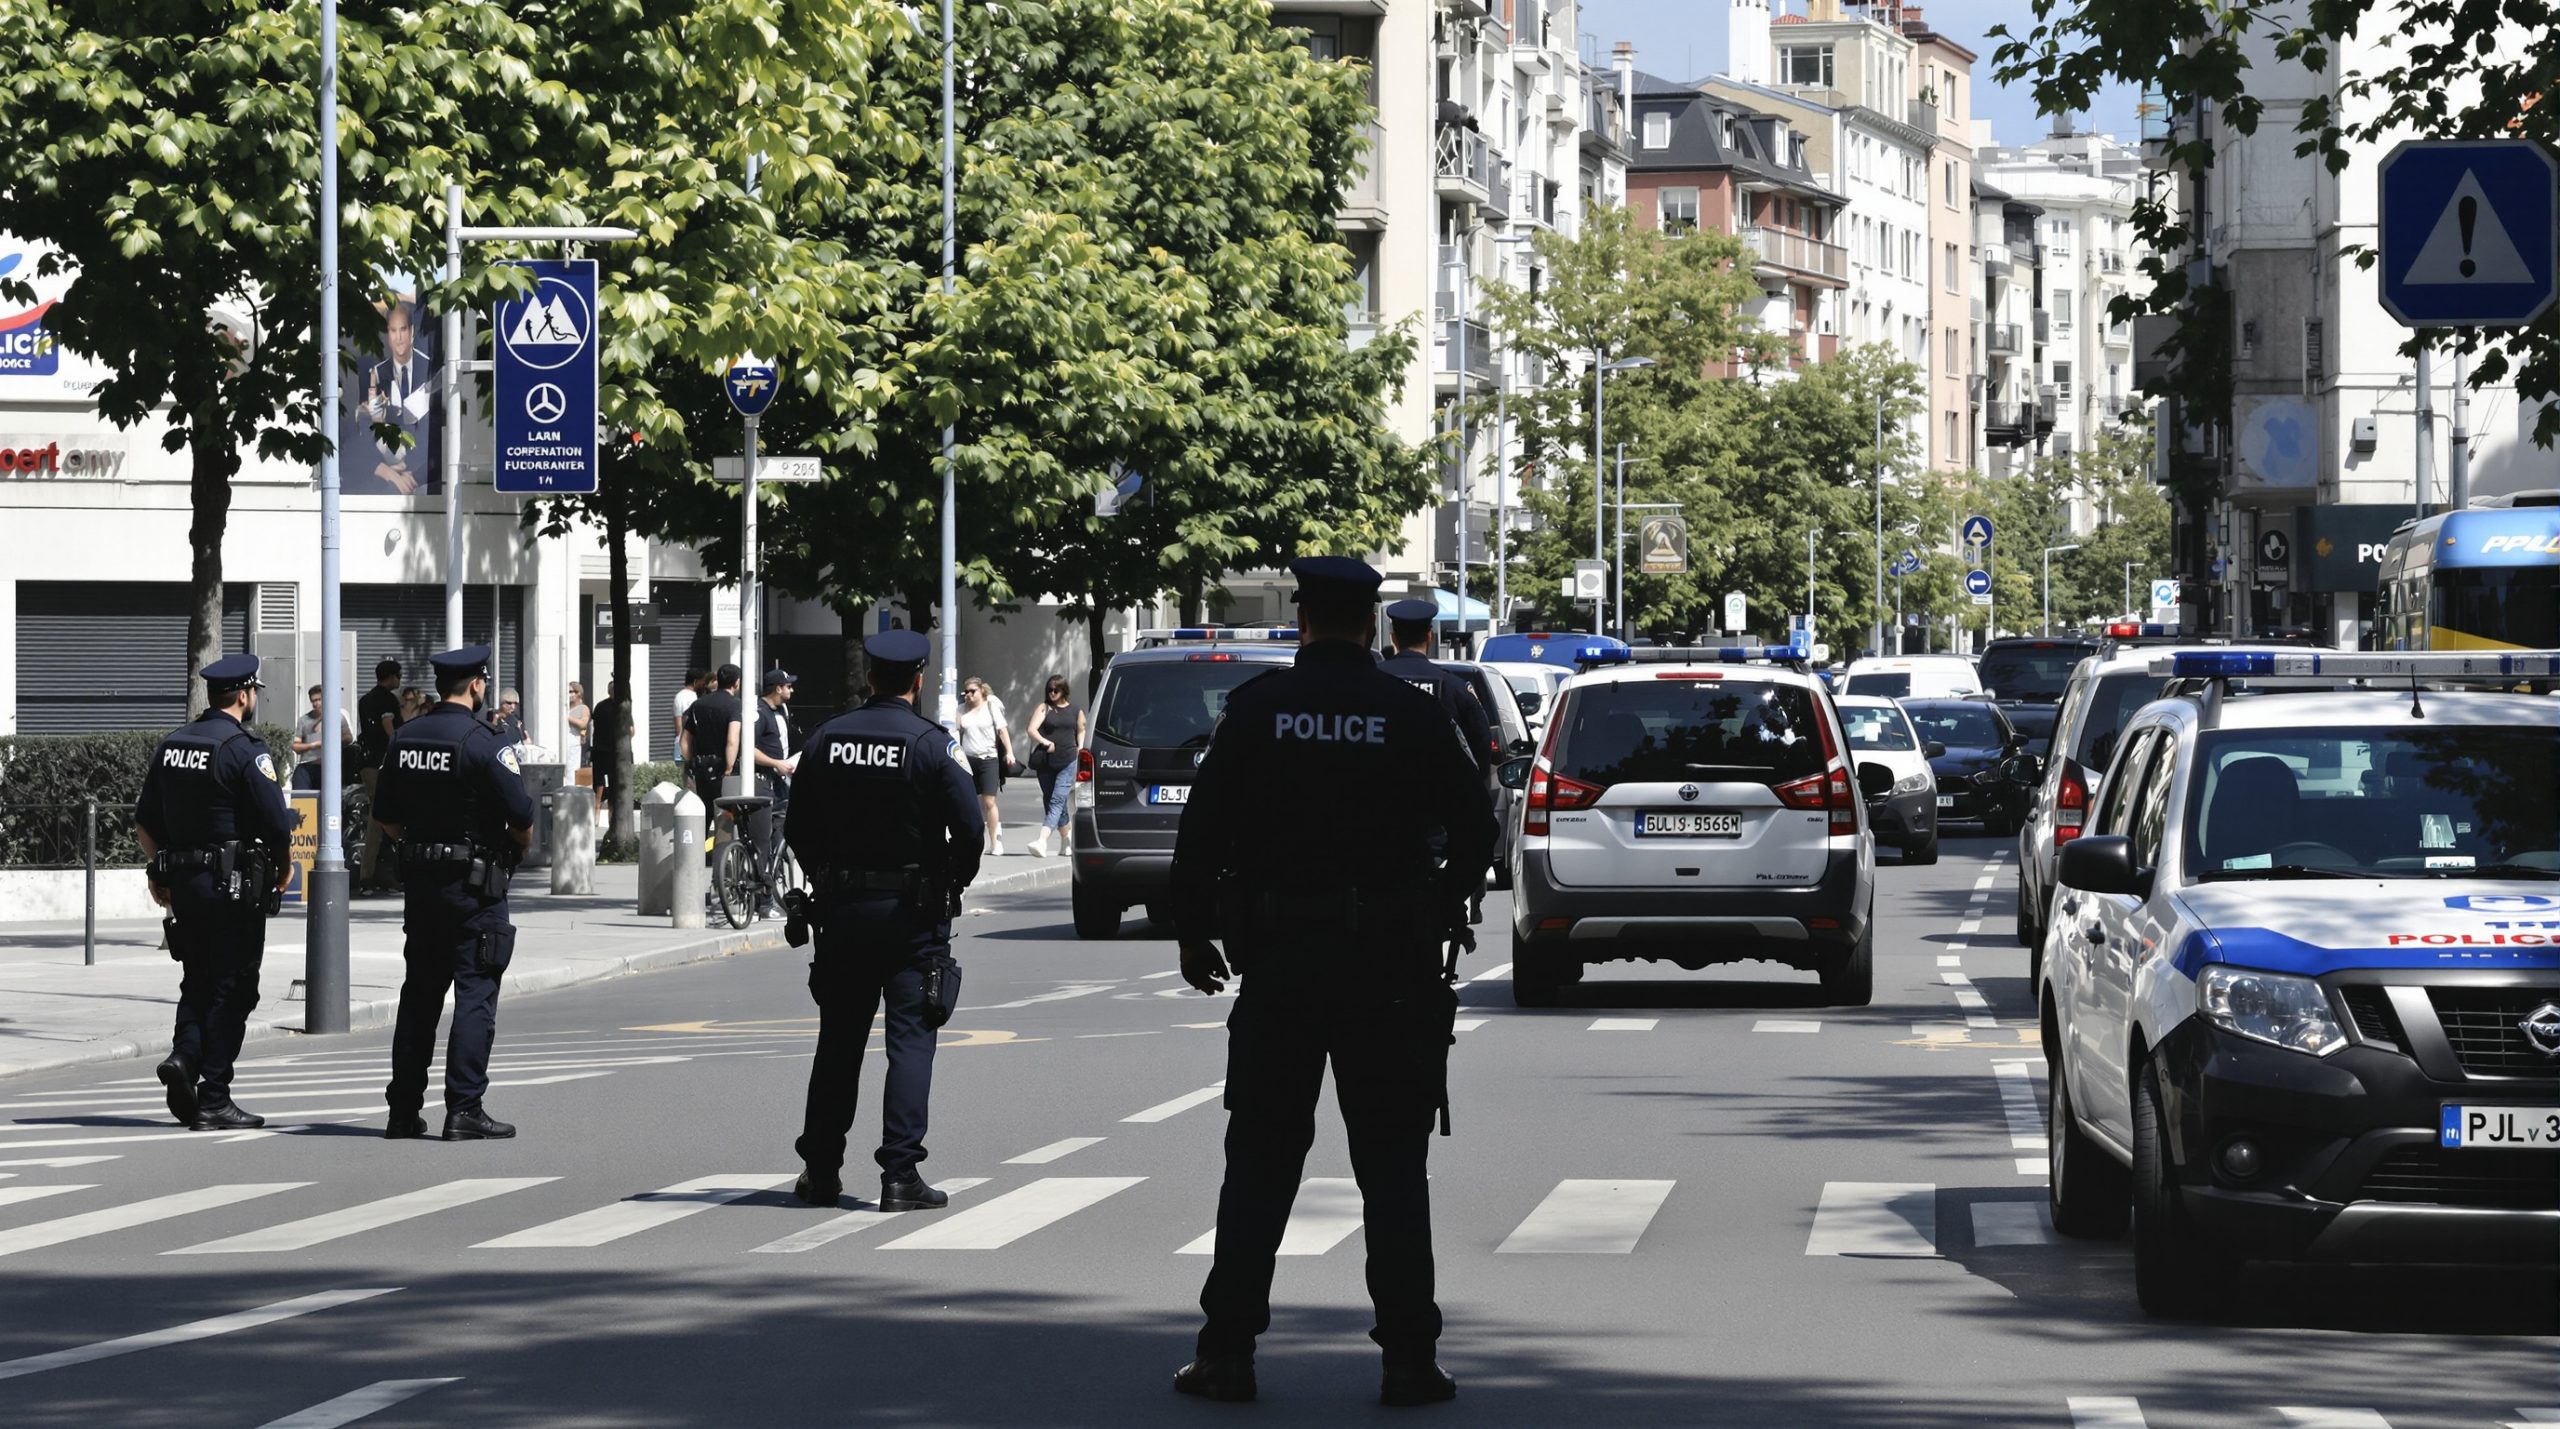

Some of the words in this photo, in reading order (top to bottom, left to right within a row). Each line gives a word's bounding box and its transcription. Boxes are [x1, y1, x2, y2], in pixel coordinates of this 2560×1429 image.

[2357, 543, 2389, 563] PO
[1275, 713, 1386, 743] POLICE
[163, 748, 210, 770] POLICE
[399, 749, 451, 771] POLICE
[829, 742, 900, 768] POLICE
[2469, 1112, 2525, 1142] PJL
